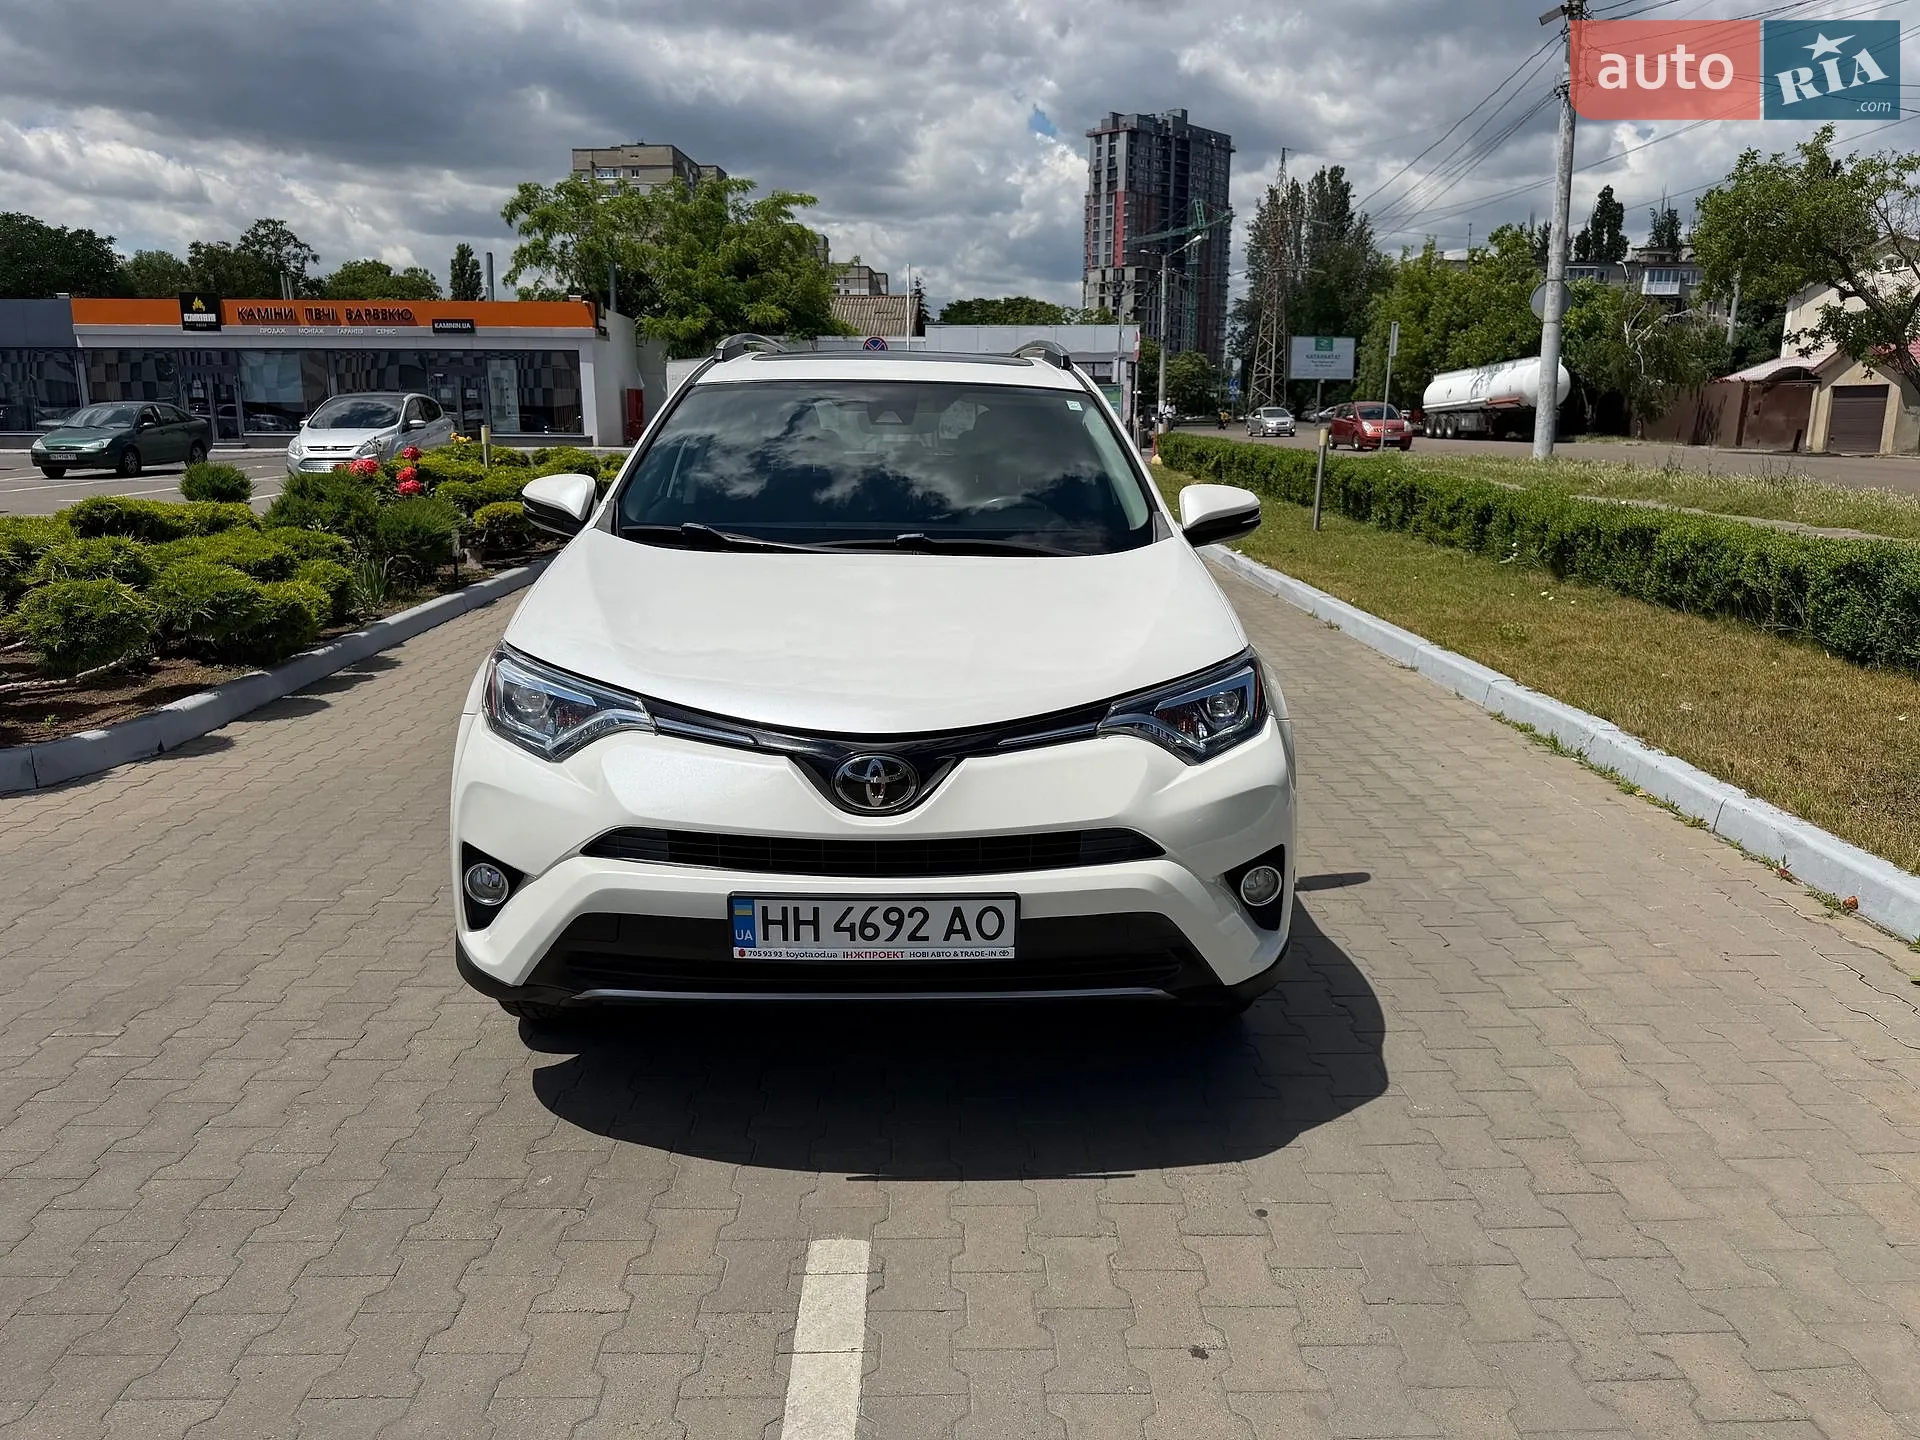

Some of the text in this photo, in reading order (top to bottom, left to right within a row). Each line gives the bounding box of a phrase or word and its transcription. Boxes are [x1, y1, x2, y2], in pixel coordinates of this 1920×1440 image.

[237, 306, 297, 320] КАМІНИ
[304, 307, 337, 321] ПЕЧІ
[833, 906, 930, 942] 4692
[735, 929, 753, 941] UA
[843, 951, 905, 959] ІНЖПРОЕКТ
[960, 950, 997, 958] TRADE-IN
